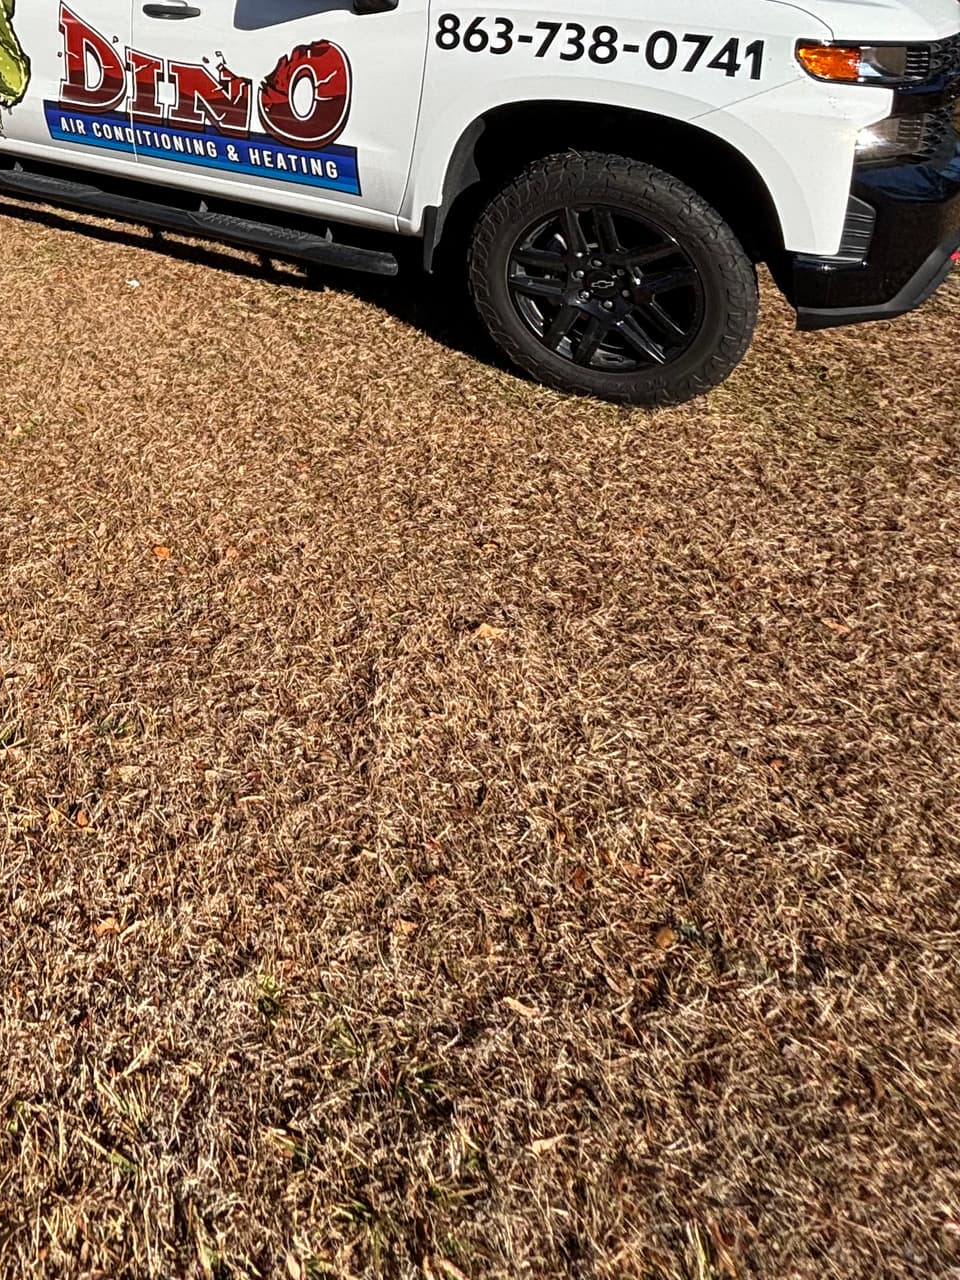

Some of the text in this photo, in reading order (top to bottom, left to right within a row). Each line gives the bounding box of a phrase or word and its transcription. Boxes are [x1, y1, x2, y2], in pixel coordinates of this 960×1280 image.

[58, 0, 353, 149] DINO
[434, 12, 765, 81] 863-738-0741
[60, 116, 339, 179] AIR CONDITIONING & HEATING
